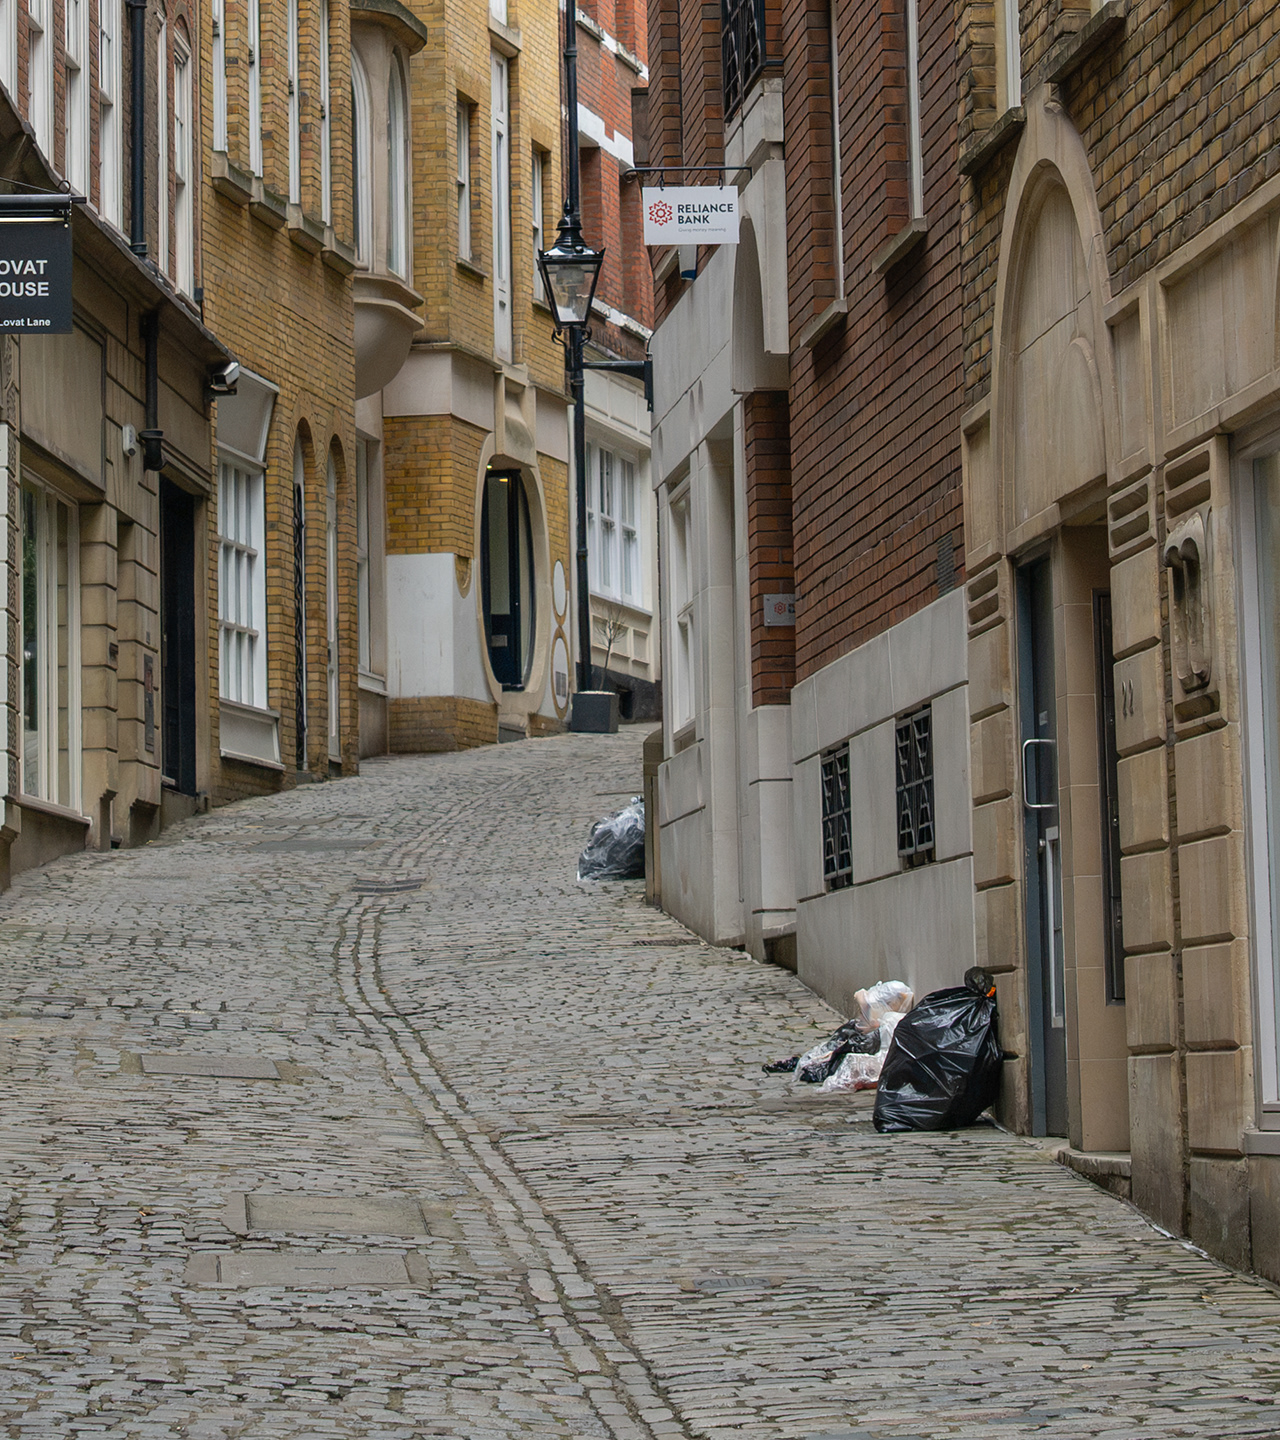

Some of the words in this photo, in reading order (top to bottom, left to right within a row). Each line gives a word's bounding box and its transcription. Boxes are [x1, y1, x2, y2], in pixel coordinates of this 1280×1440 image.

[678, 203, 733, 213] RELIANCE
[678, 215, 710, 224] BANK
[26, 318, 51, 327] Lane
